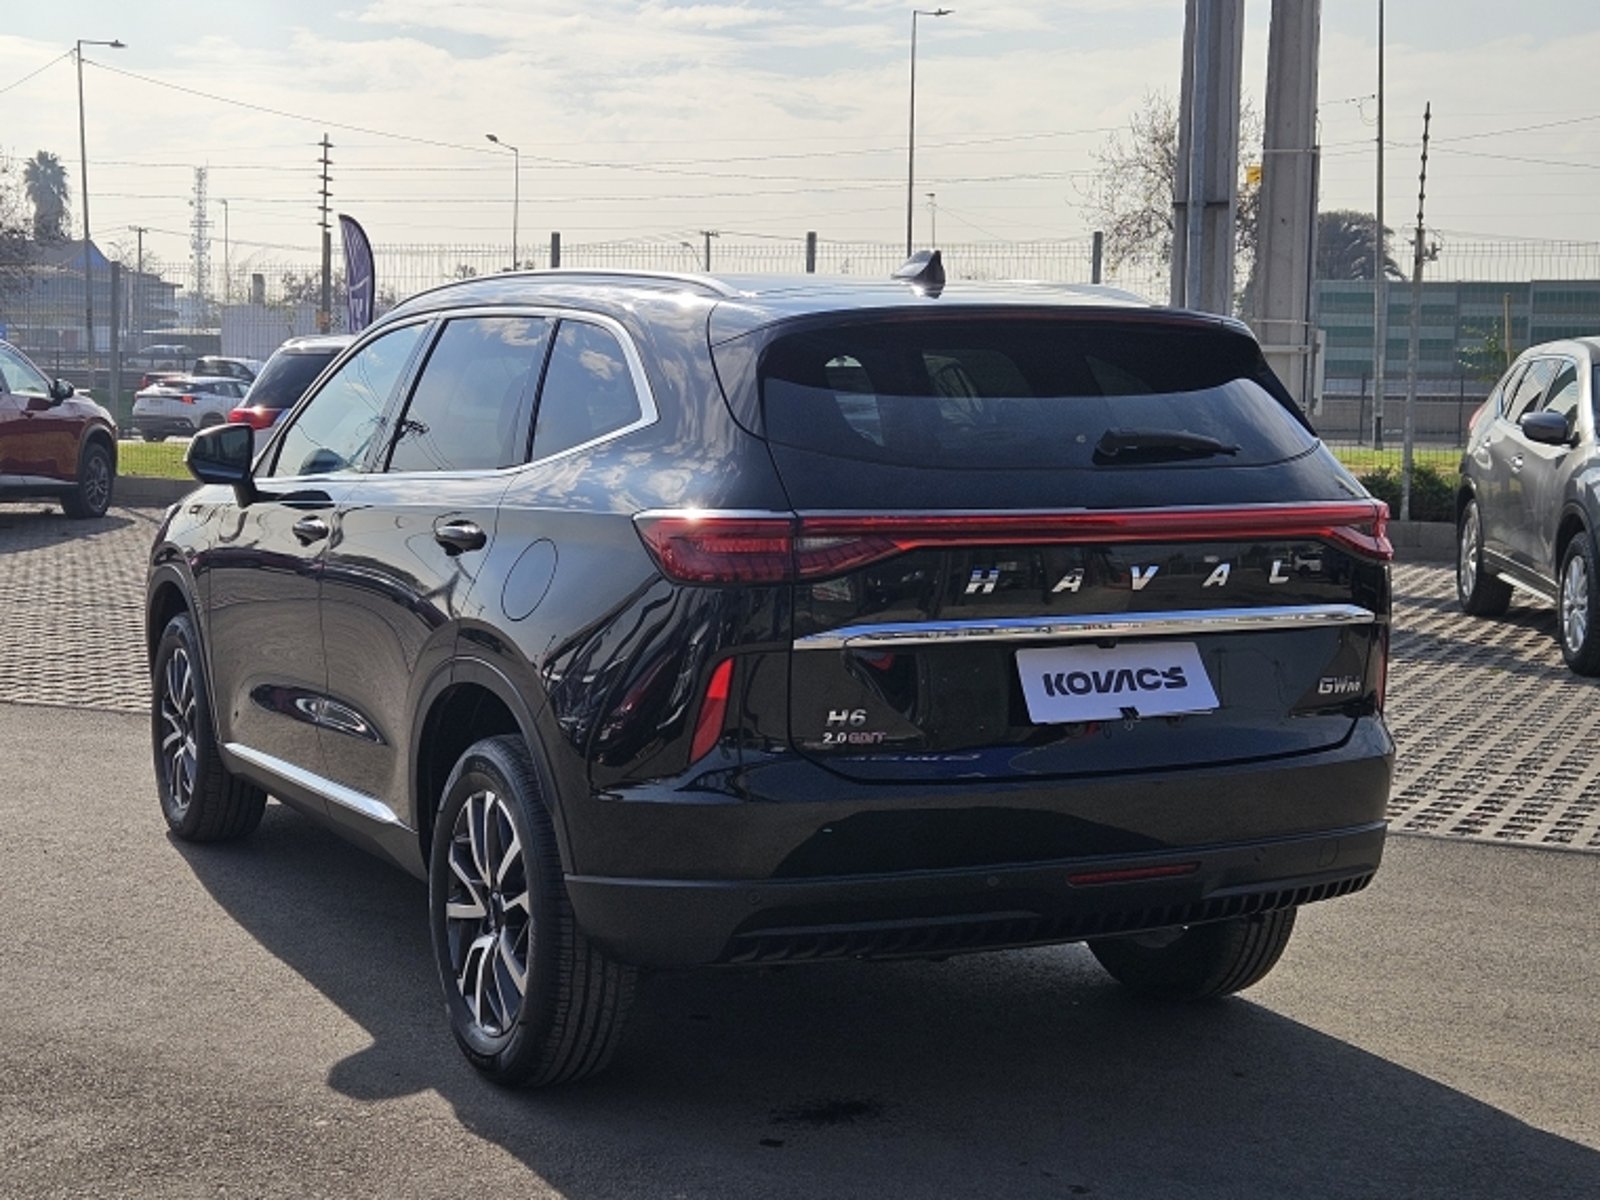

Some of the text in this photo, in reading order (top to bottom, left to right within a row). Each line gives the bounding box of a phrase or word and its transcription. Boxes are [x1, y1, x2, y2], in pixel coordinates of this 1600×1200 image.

[965, 560, 1289, 594] HAVAL
[1042, 666, 1188, 697] KOVACS
[1318, 675, 1361, 694] GWM
[825, 709, 867, 728] H6
